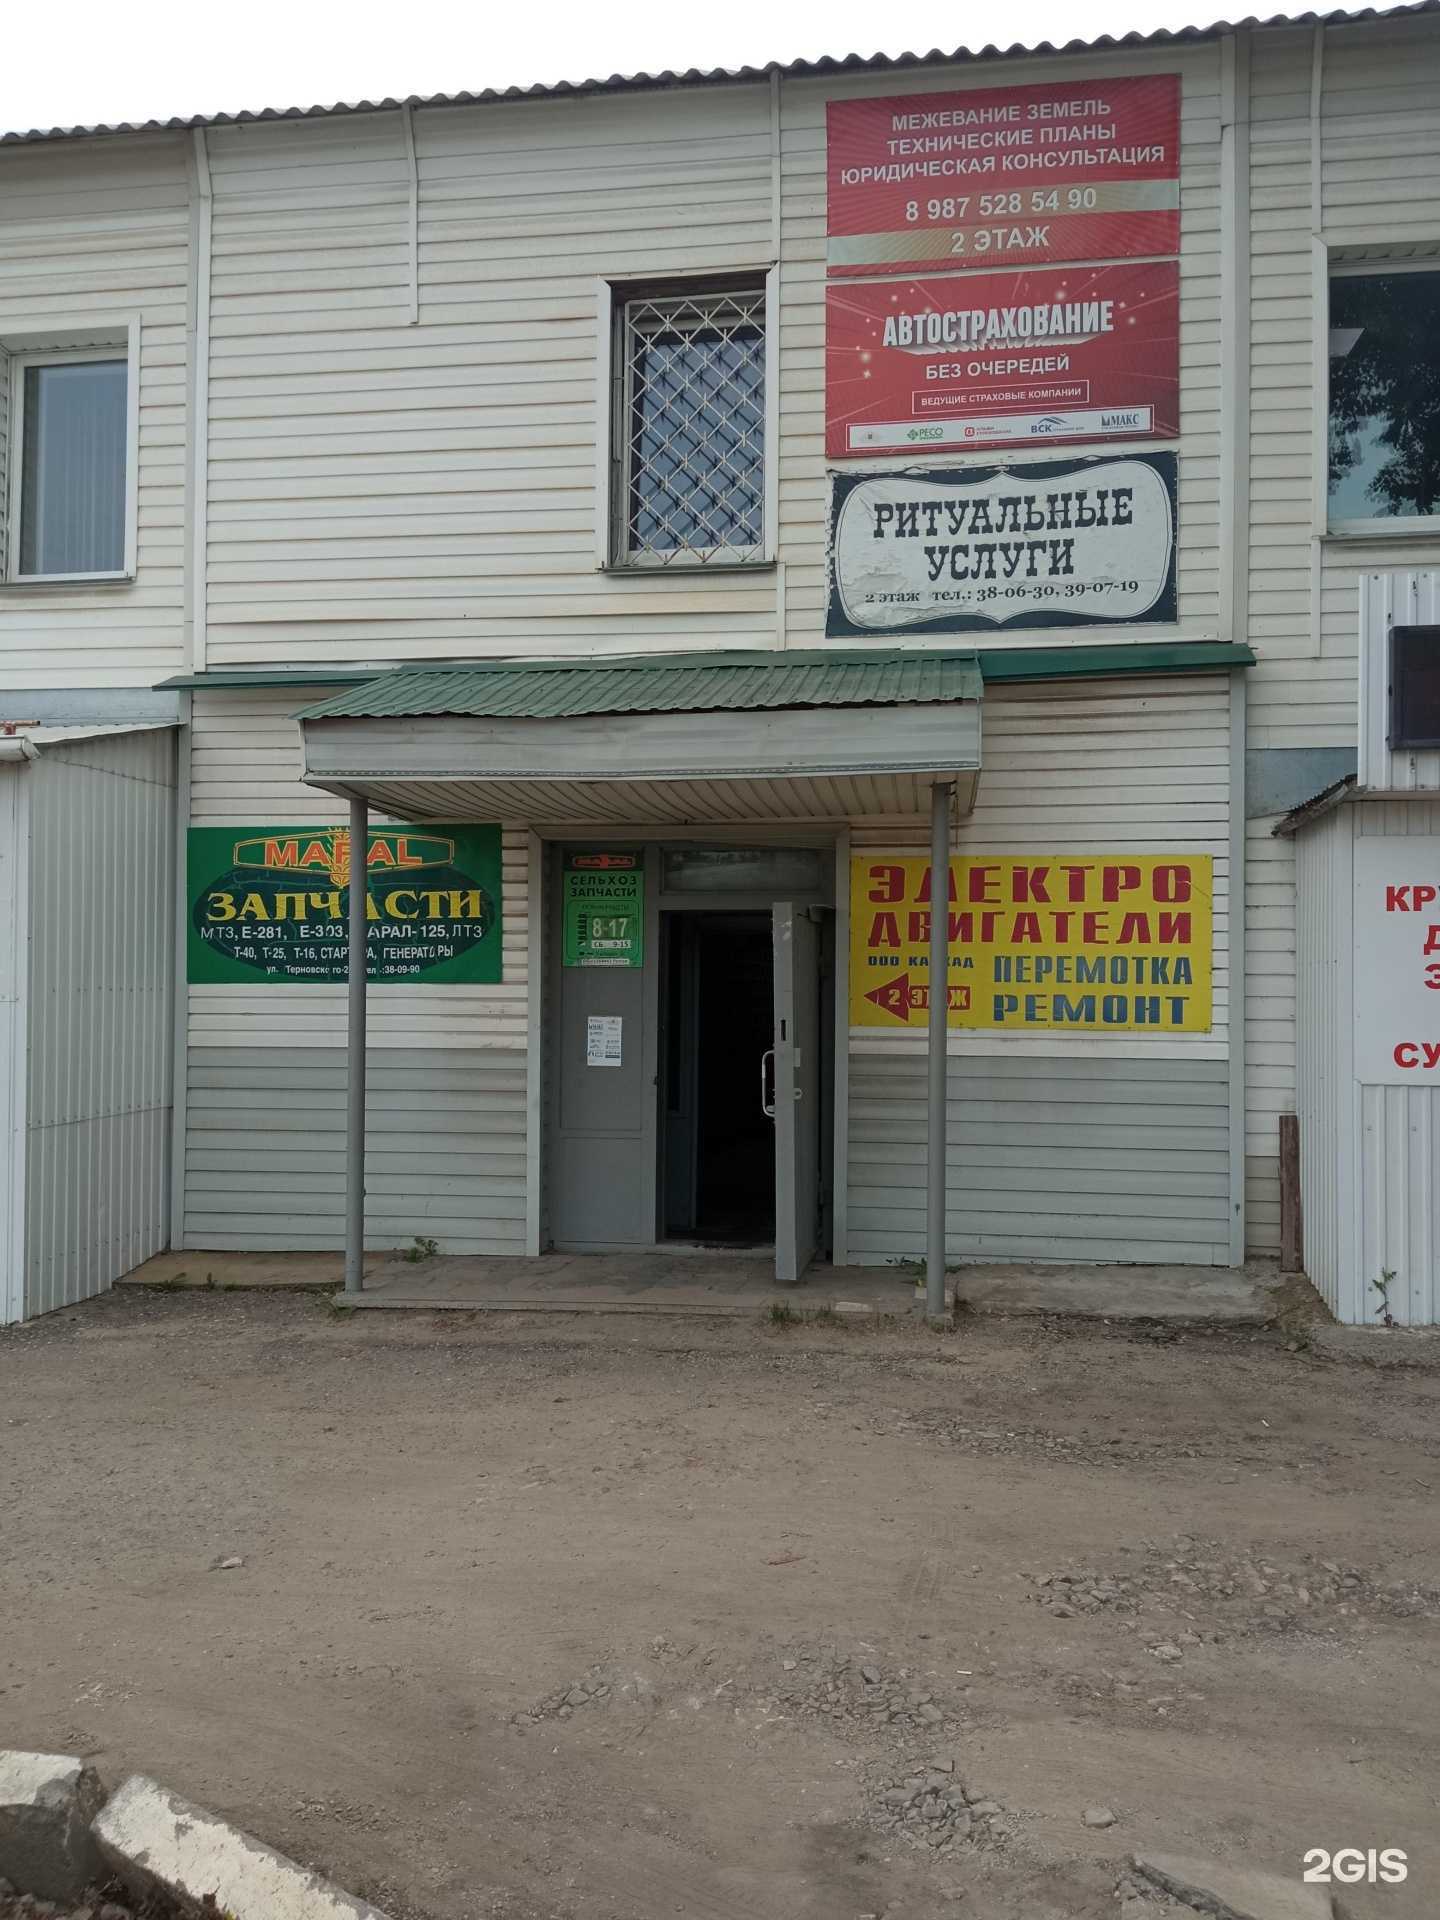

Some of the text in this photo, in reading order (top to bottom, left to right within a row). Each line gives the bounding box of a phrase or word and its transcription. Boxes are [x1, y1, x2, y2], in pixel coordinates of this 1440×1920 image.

[892, 99, 1111, 131] МЕЖЕВАНИЕ ЗЕМЕЛЬ
[887, 124, 1116, 156] ТЕХНИЧЕСКИЕ ПЛАНЫ
[841, 146, 1165, 185] ЮРИДИЧЕСКАЯ КОНСУЛЬТАЦИЯ
[905, 188, 1097, 221] 8 987 528 54 90
[951, 225, 1050, 253] 2 ЭТАЖ
[883, 300, 1114, 348] АВТОСТРАХОВАНИЕ
[926, 353, 1070, 380] БЕЗ ОЧЕРЕДЕЙ
[921, 387, 1081, 406] ВЕДУЩИЕ СТРАХОВЫЕ КОМПАНИИ
[1031, 424, 1052, 434] ВСК
[873, 488, 1133, 538] РИТУАЛЬНЫЕ
[924, 538, 1075, 581] УСЛУГИ
[865, 593, 875, 603] 2
[879, 591, 920, 603] этаж
[932, 590, 972, 601] тел.:
[1064, 579, 1139, 599] 39-07-19
[570, 876, 637, 885] СЕЛЬХОЗ
[571, 887, 637, 897] ЗАПЧАСТИ
[867, 865, 1192, 904] ЭЛЕКТРО
[1386, 885, 1440, 912] КР
[452, 924, 483, 938] ЛТЗ
[592, 917, 628, 938] 8-17
[867, 911, 1192, 948] ДВИГАТЕЛИ
[993, 954, 1193, 985] ПЕРЕМОТКА
[888, 989, 900, 1006] 2
[993, 993, 1190, 1025] РЕМОНТ
